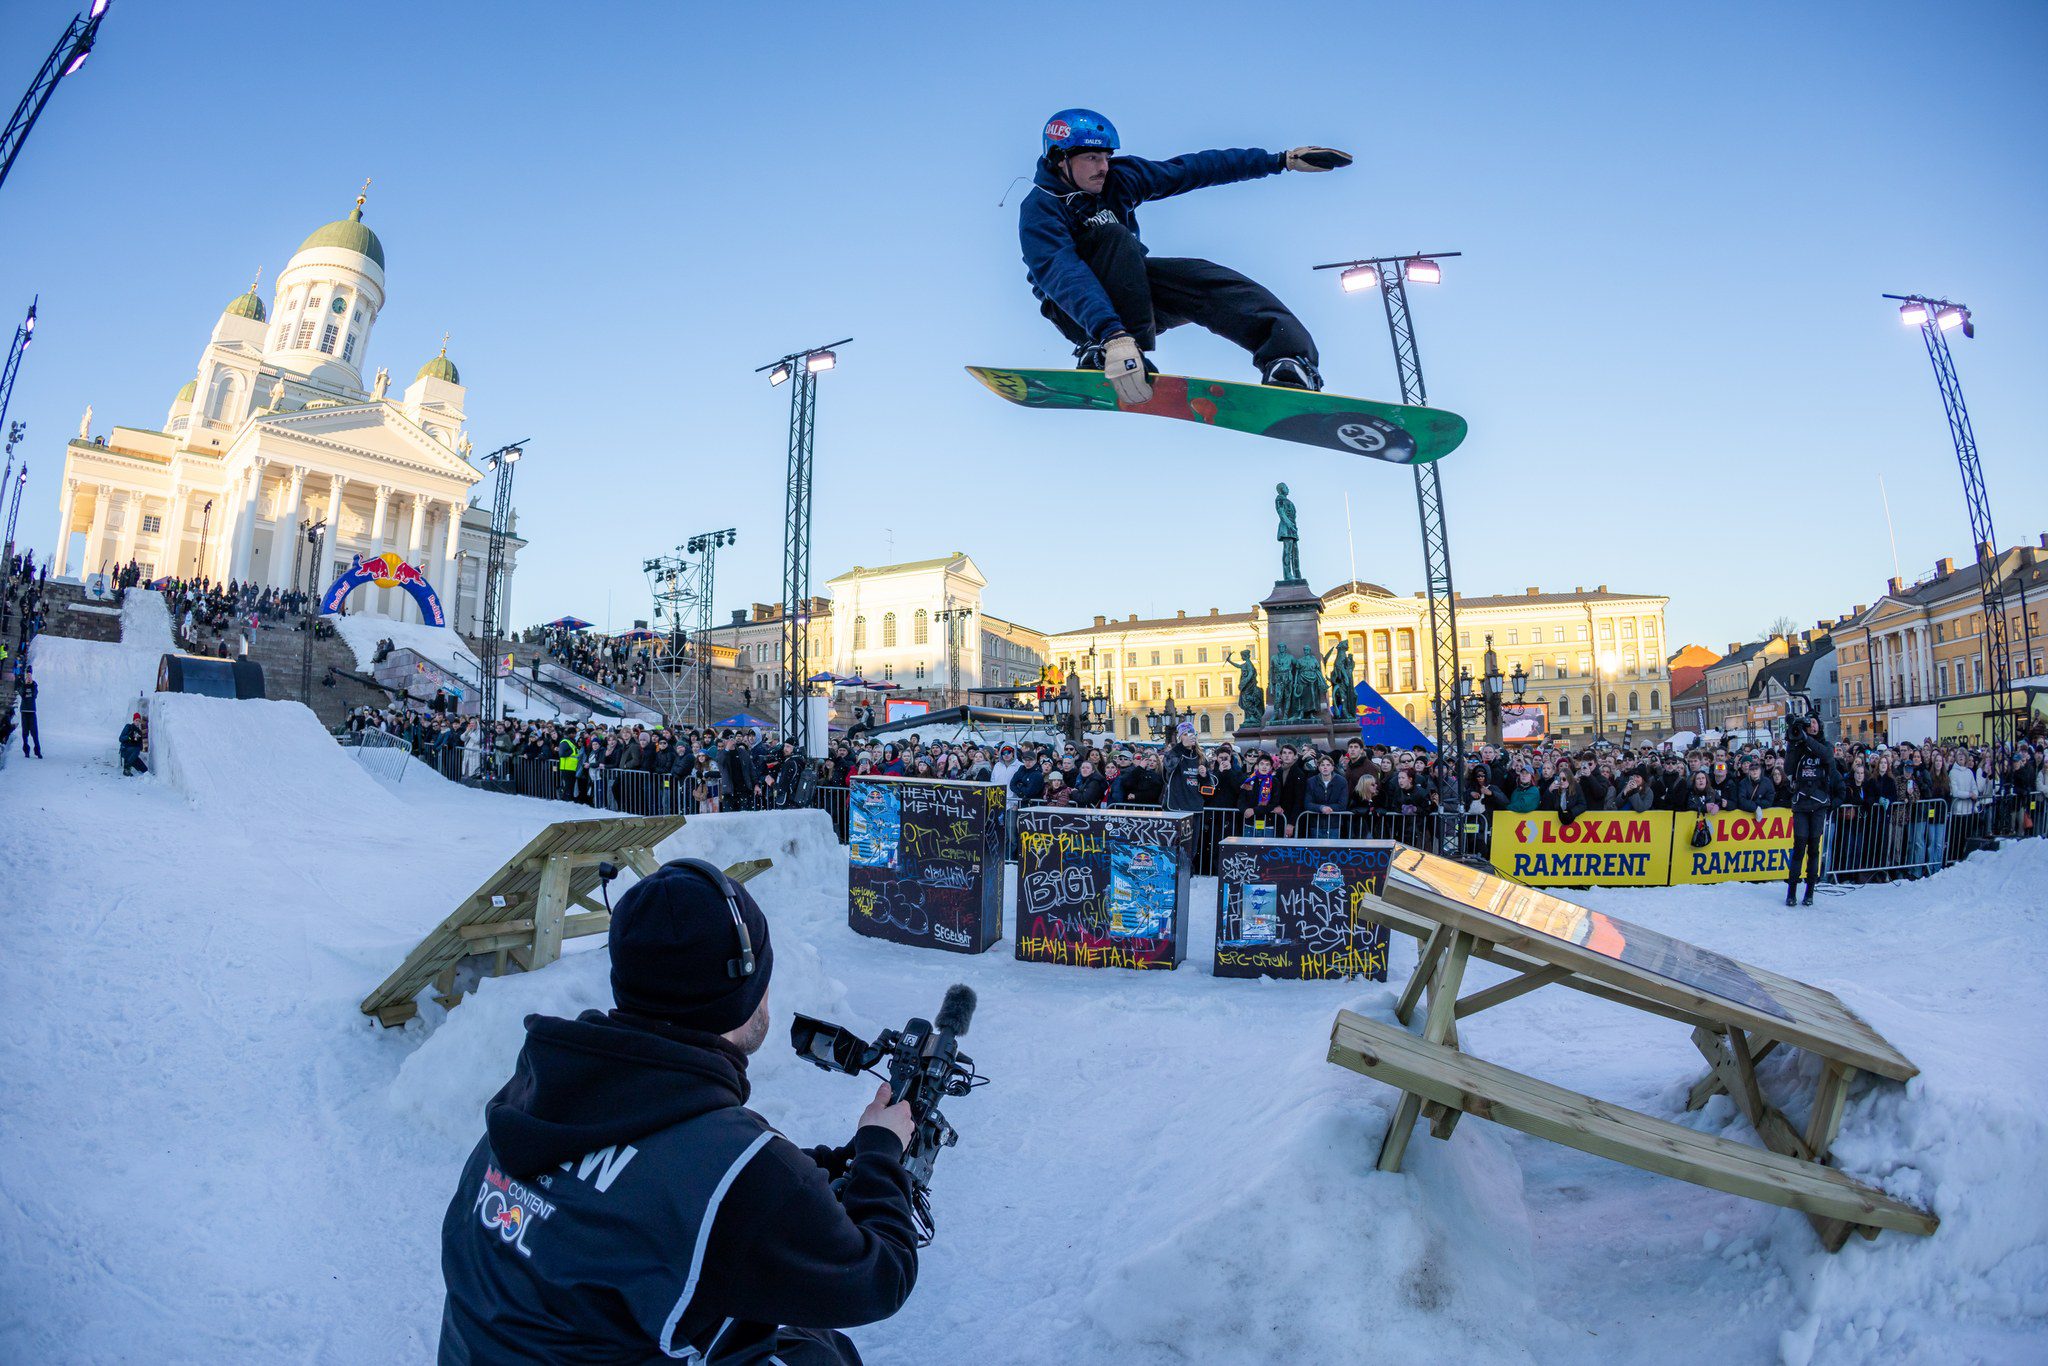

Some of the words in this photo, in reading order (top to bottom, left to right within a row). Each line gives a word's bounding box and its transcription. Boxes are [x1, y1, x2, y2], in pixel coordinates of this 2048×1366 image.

[901, 787, 963, 803] HEAVY
[1541, 820, 1651, 844] LOXAM
[1513, 853, 1651, 876] RAMIRENT
[1691, 848, 1794, 876] RAMIREN
[508, 1182, 556, 1219] CONTENT
[473, 1182, 532, 1256] POOL
